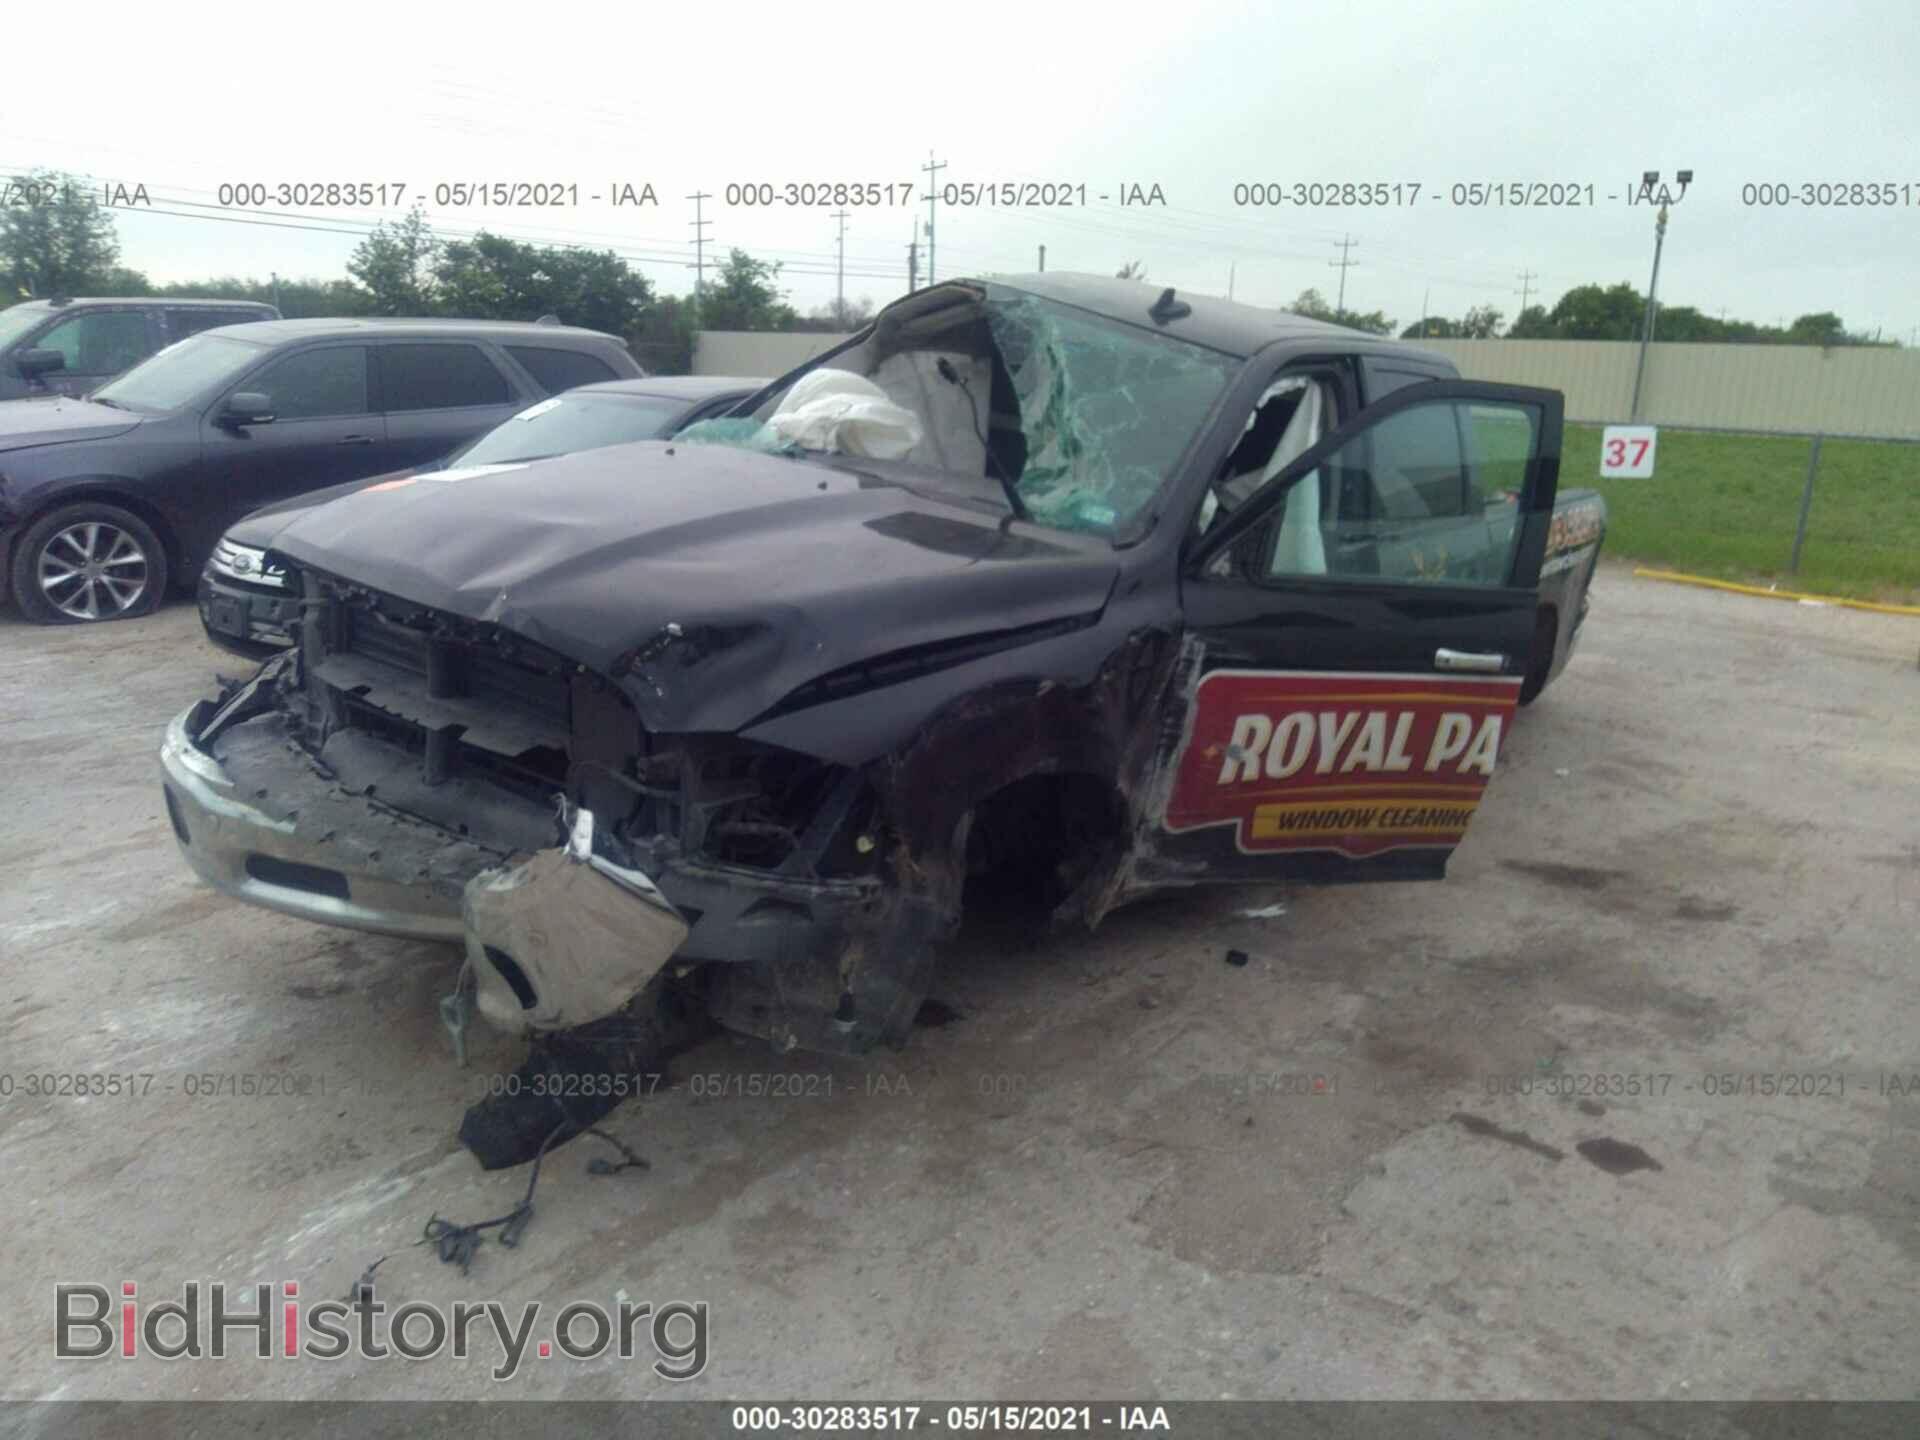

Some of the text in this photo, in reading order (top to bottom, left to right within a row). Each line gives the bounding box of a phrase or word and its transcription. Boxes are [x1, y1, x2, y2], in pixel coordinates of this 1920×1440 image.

[1606, 439, 1650, 468] 37
[1217, 711, 1502, 784] ROYAL PA
[1278, 809, 1376, 830] WINDOW
